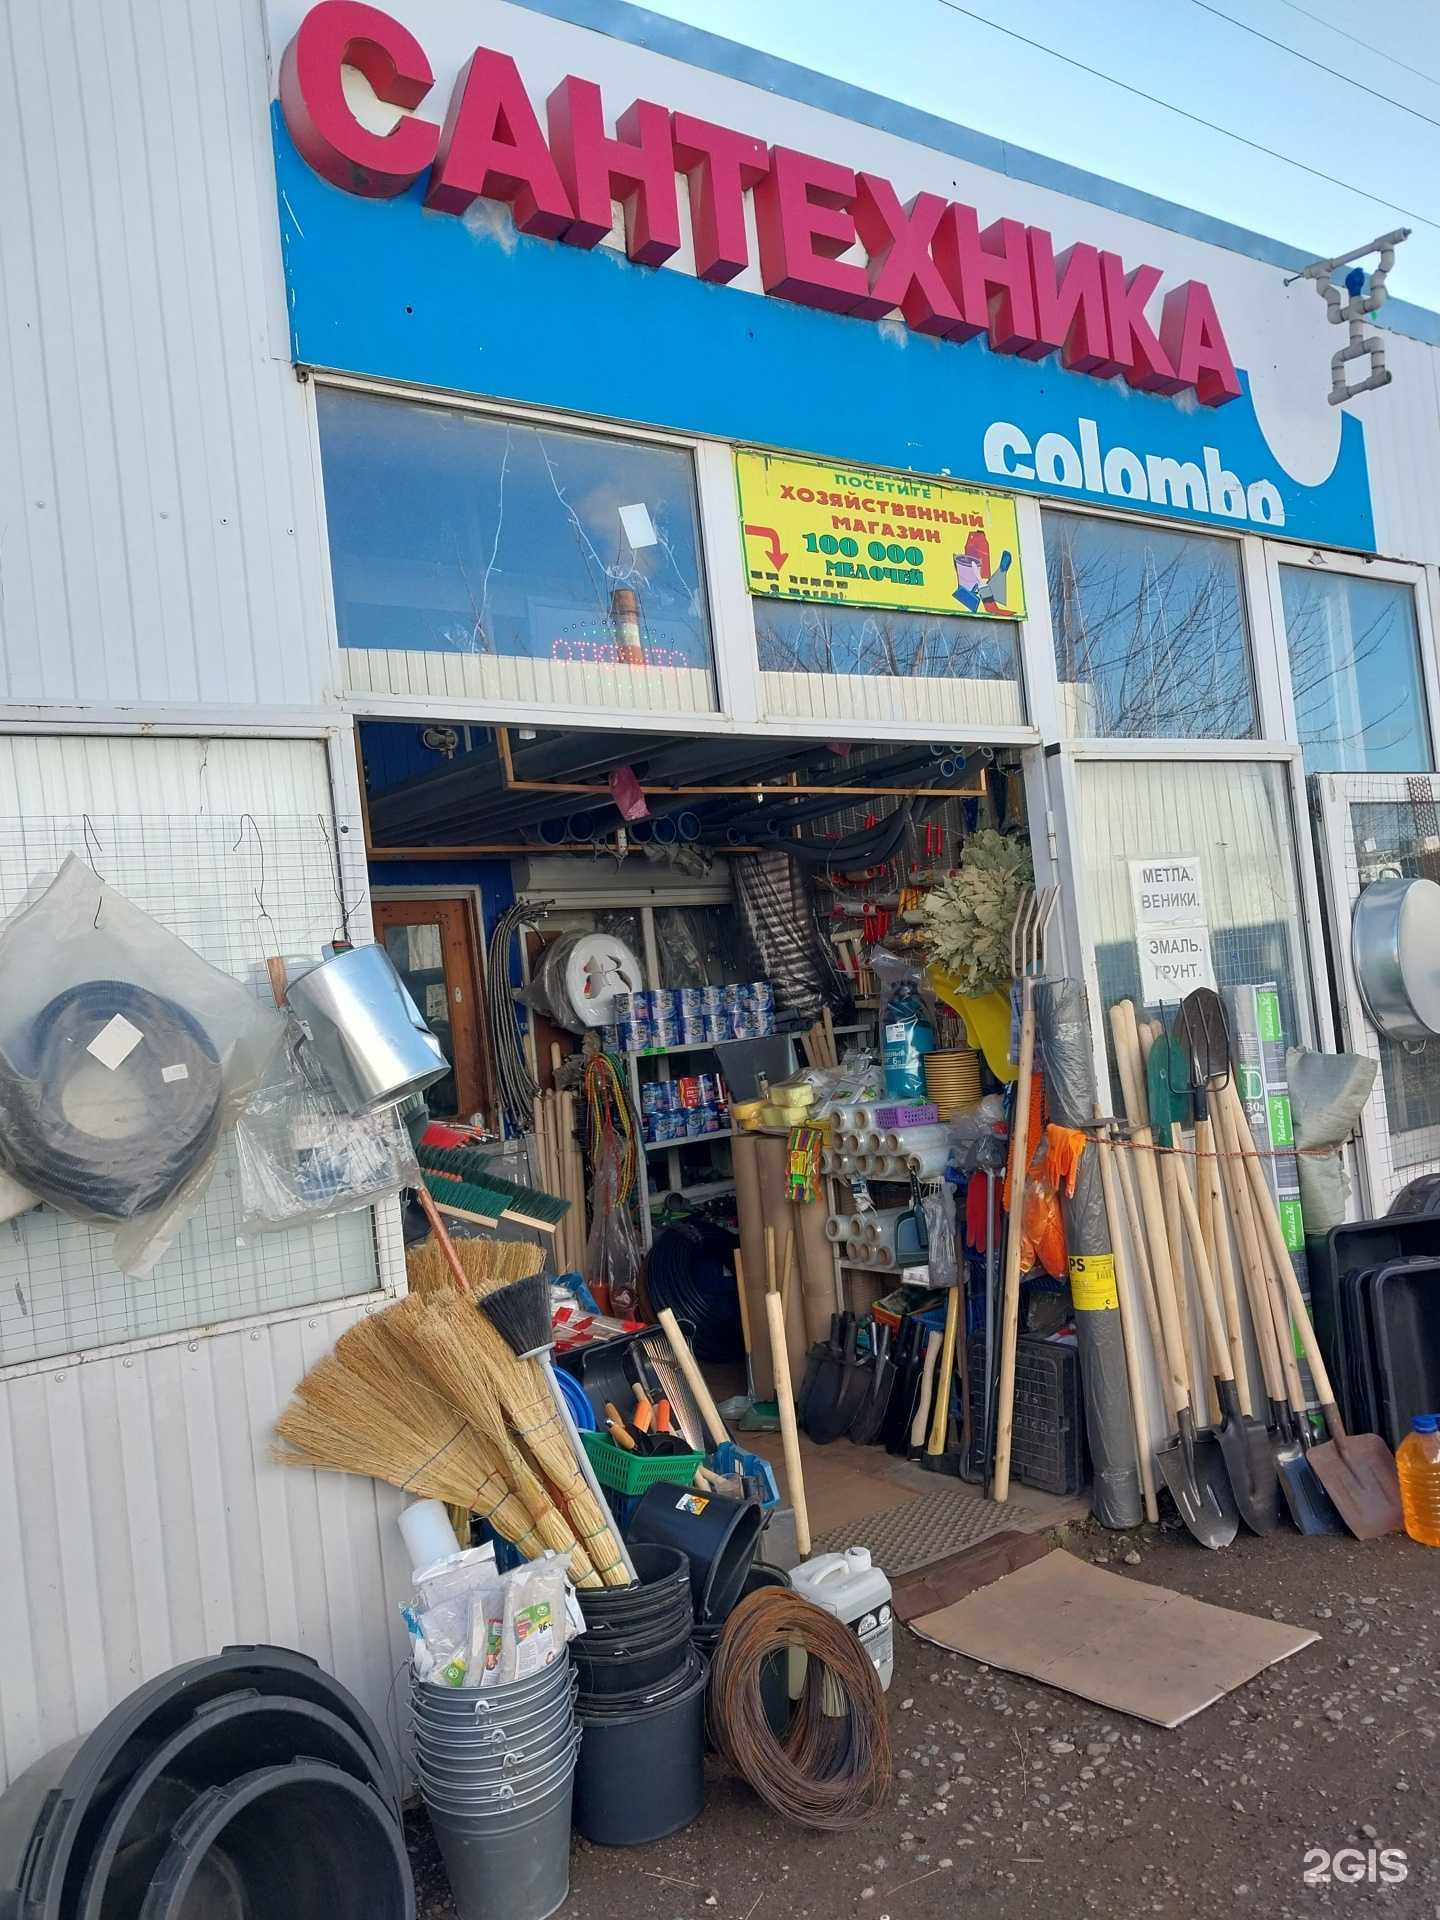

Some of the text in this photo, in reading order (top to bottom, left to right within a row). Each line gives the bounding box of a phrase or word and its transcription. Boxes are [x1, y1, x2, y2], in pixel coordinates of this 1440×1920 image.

[279, 0, 1242, 408] САНТЕХНИКА
[834, 473, 932, 499] ПОСЕТИТЕ
[983, 417, 1285, 528] colombo
[780, 484, 985, 529] ХОЗЯЙСТВЕННЫЙ
[831, 515, 942, 544] МАГАЗИН
[802, 532, 925, 567] 100 000
[825, 559, 925, 587] МЕЛОЧЕЙ
[1142, 867, 1194, 884] МЕТЛА.
[1142, 892, 1200, 909] ВЕНИКИ.
[1149, 938, 1202, 954] ЭМАЛЬ.
